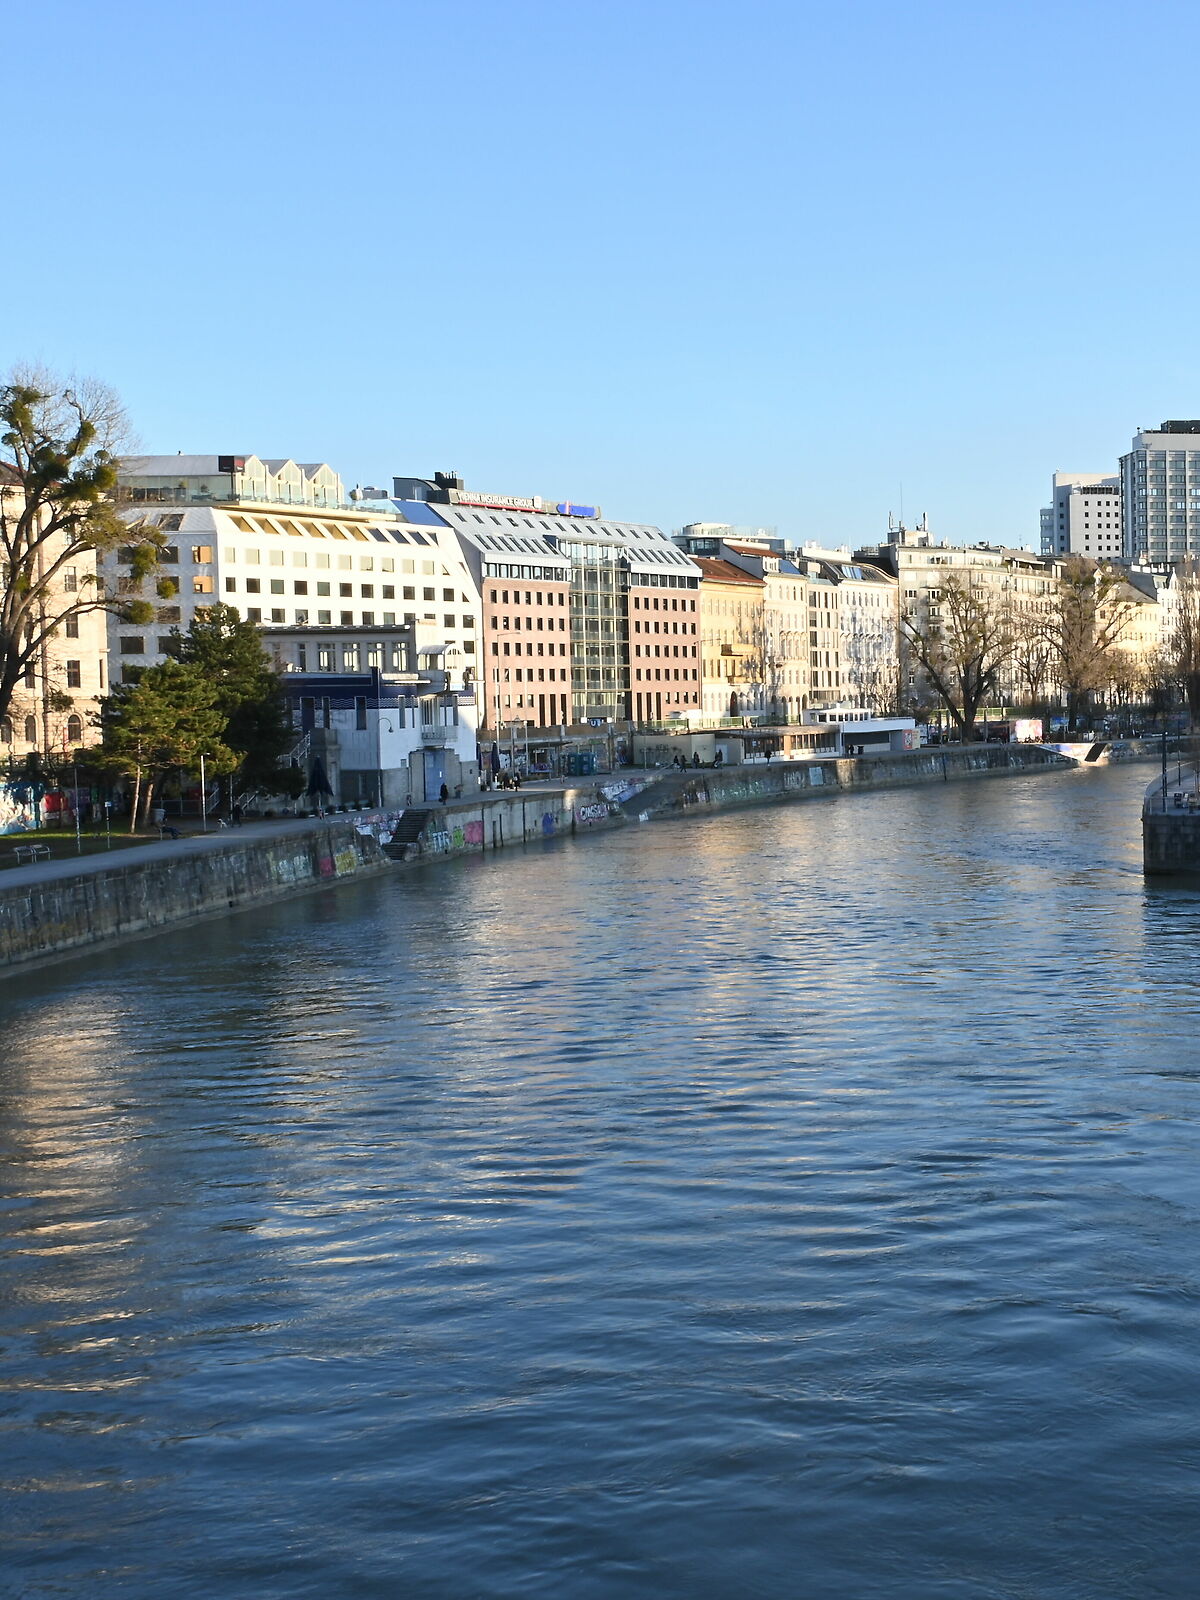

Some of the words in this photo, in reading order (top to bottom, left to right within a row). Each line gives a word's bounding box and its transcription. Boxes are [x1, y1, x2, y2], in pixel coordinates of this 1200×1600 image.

[458, 492, 480, 503] VIENNA
[480, 494, 514, 506] INSURANCE
[514, 498, 533, 509] GROUP
